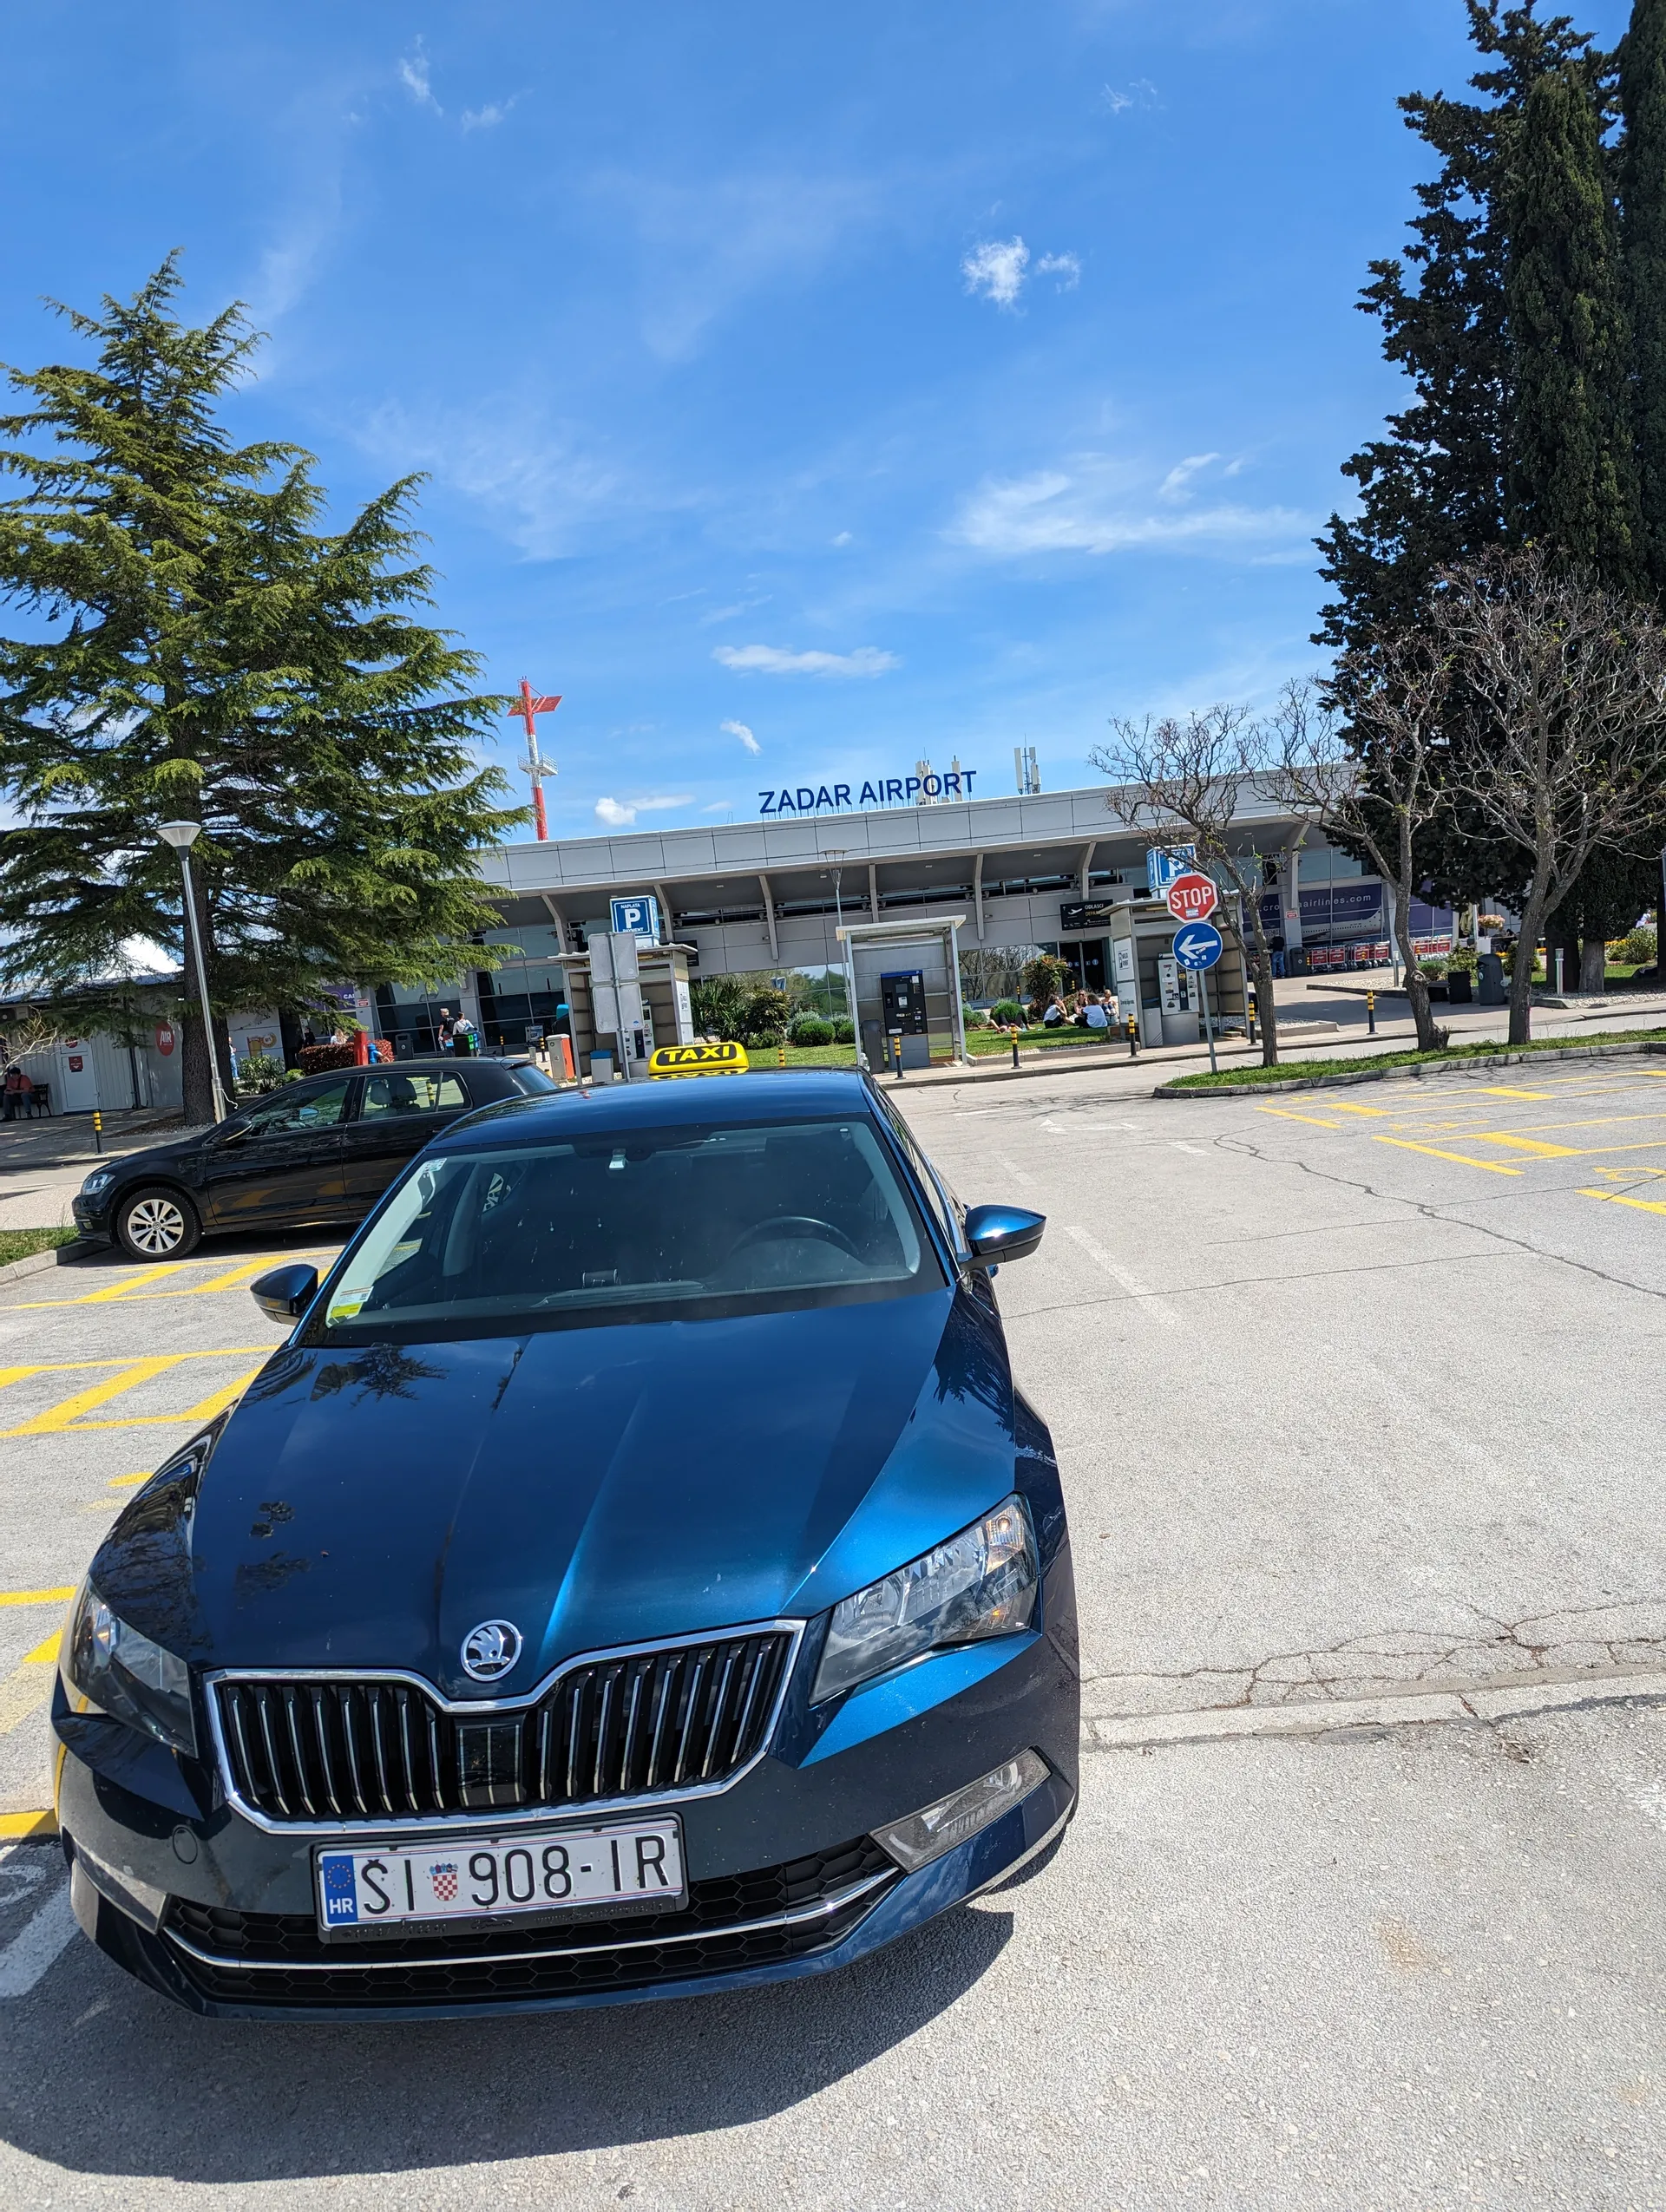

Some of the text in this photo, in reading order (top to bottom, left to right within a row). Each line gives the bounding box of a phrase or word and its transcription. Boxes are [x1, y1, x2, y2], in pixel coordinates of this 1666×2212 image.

[758, 770, 977, 814] ZADAR AIRPORT
[1171, 886, 1212, 910] STOP
[625, 908, 641, 929] P
[664, 1045, 731, 1063] TAXI
[469, 1834, 671, 1907] 908-IR
[329, 1897, 354, 1914] HR
